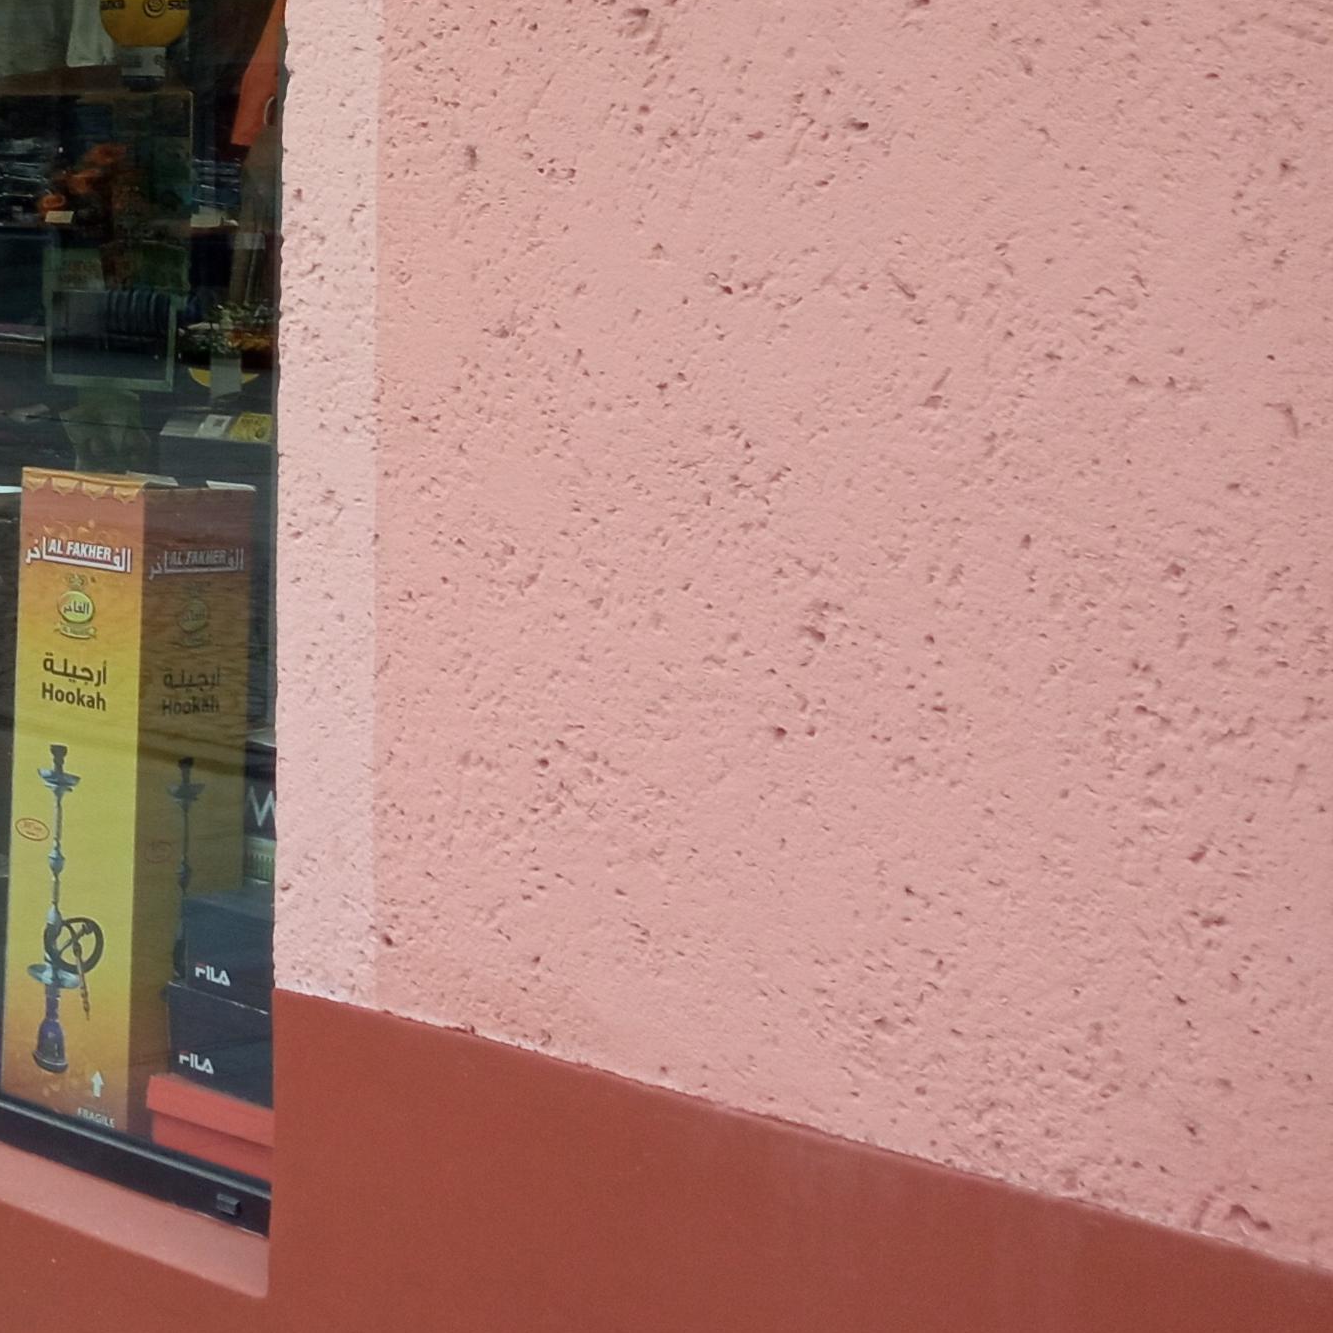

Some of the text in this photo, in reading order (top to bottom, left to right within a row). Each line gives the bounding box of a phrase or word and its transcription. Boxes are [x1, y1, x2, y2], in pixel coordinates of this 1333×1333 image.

[48, 538, 111, 560] AL FAKHER
[42, 682, 107, 711] Hookah
[195, 963, 231, 987] FILA
[178, 1050, 214, 1075] FILA
